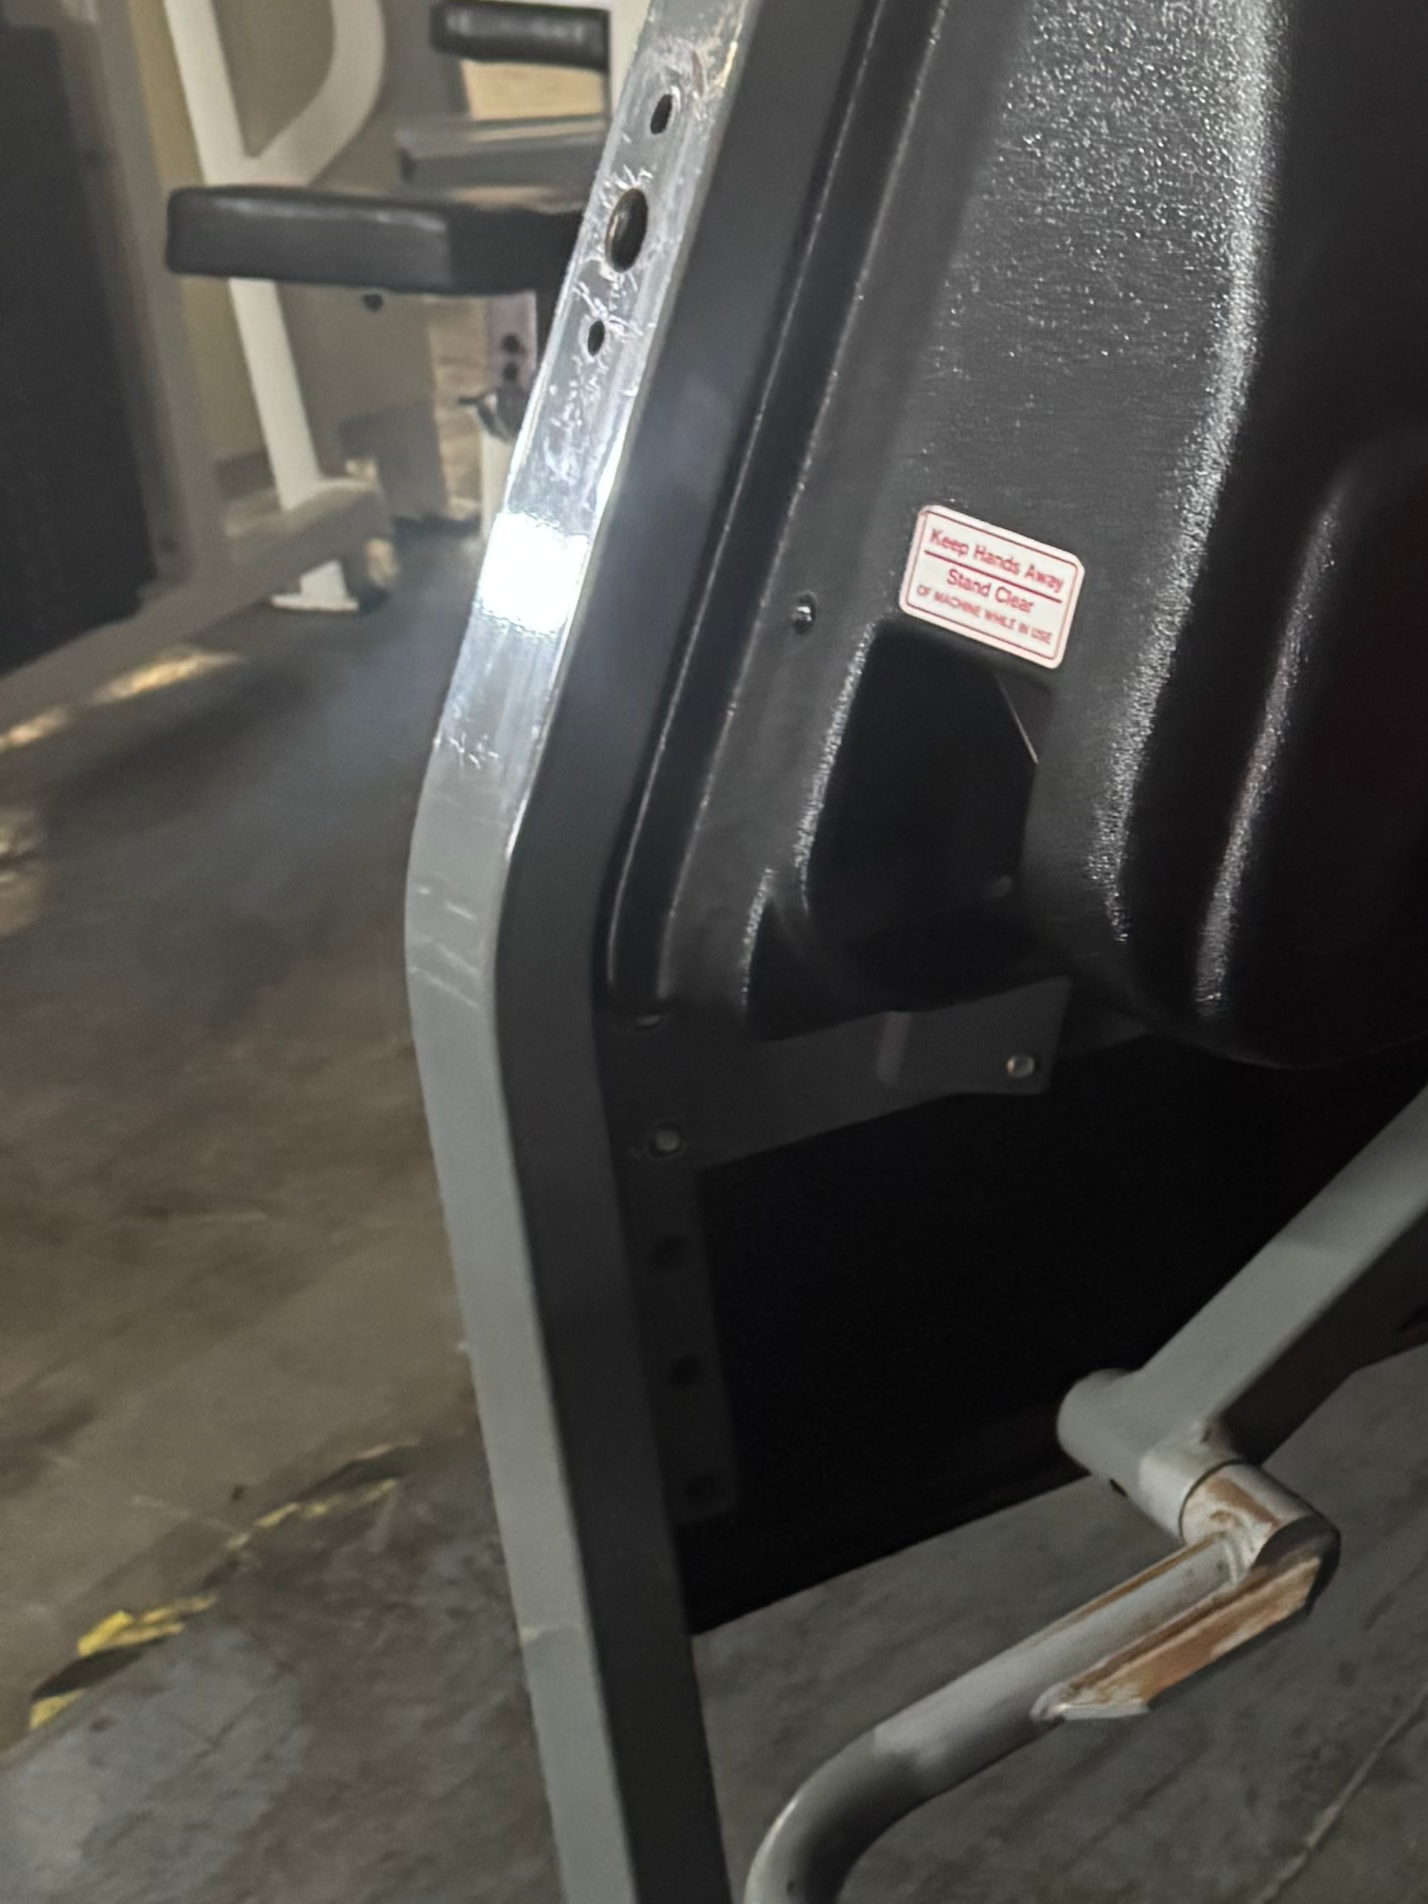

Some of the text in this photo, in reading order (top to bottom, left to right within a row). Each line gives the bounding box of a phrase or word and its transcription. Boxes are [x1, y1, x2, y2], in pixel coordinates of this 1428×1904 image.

[930, 529, 1065, 594] Keep Hands Away
[946, 568, 1034, 613] Stand Clear
[916, 584, 1053, 645] OF MACHINE WHILE IN USE
